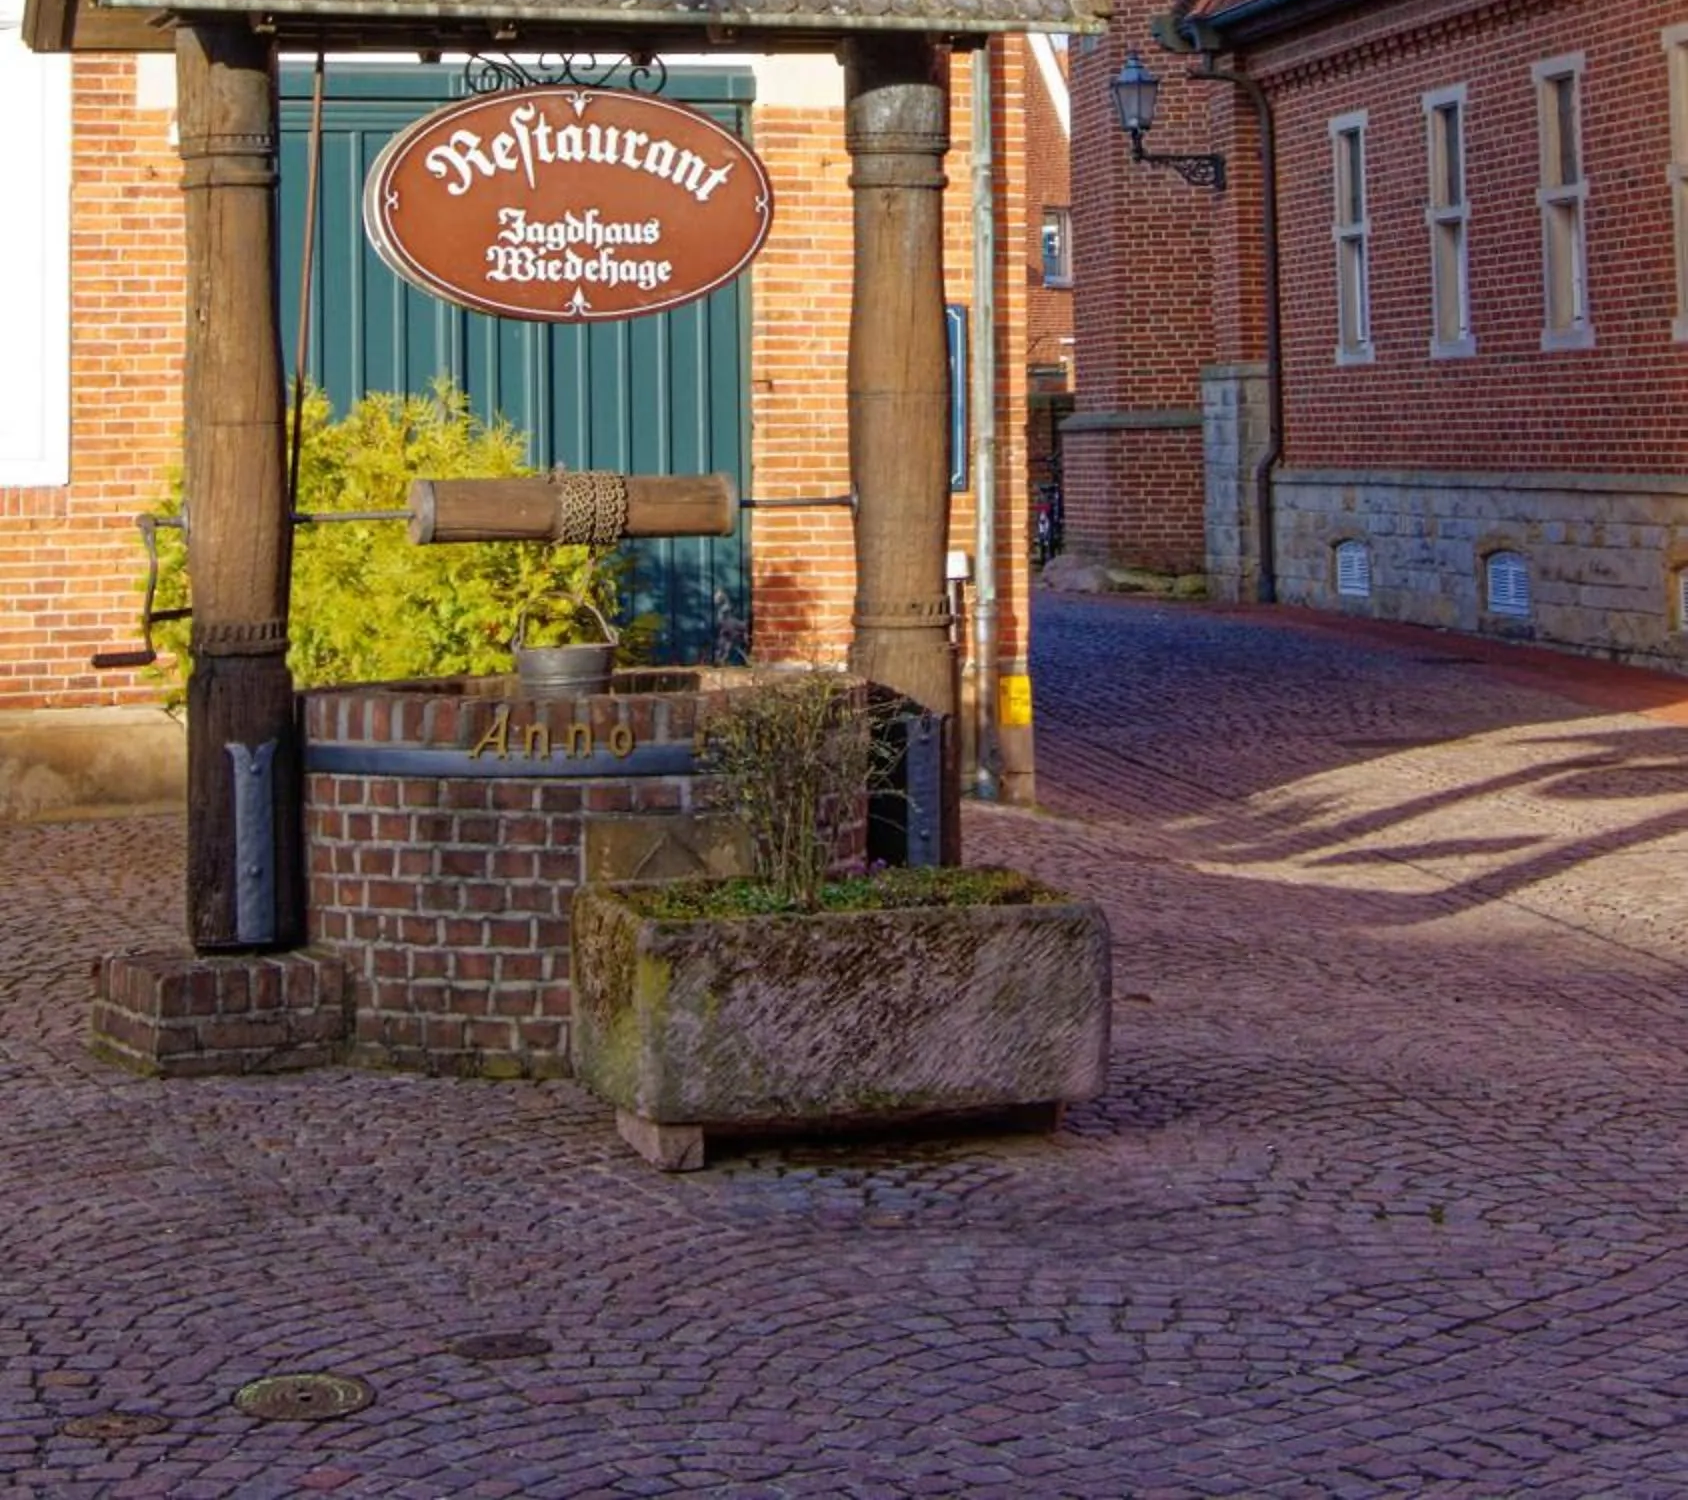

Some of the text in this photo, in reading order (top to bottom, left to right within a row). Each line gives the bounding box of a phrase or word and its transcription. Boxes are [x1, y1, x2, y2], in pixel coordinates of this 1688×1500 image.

[498, 207, 661, 251] Jagdhaus
[485, 245, 673, 290] Wiedehage
[468, 703, 634, 761] Anno
